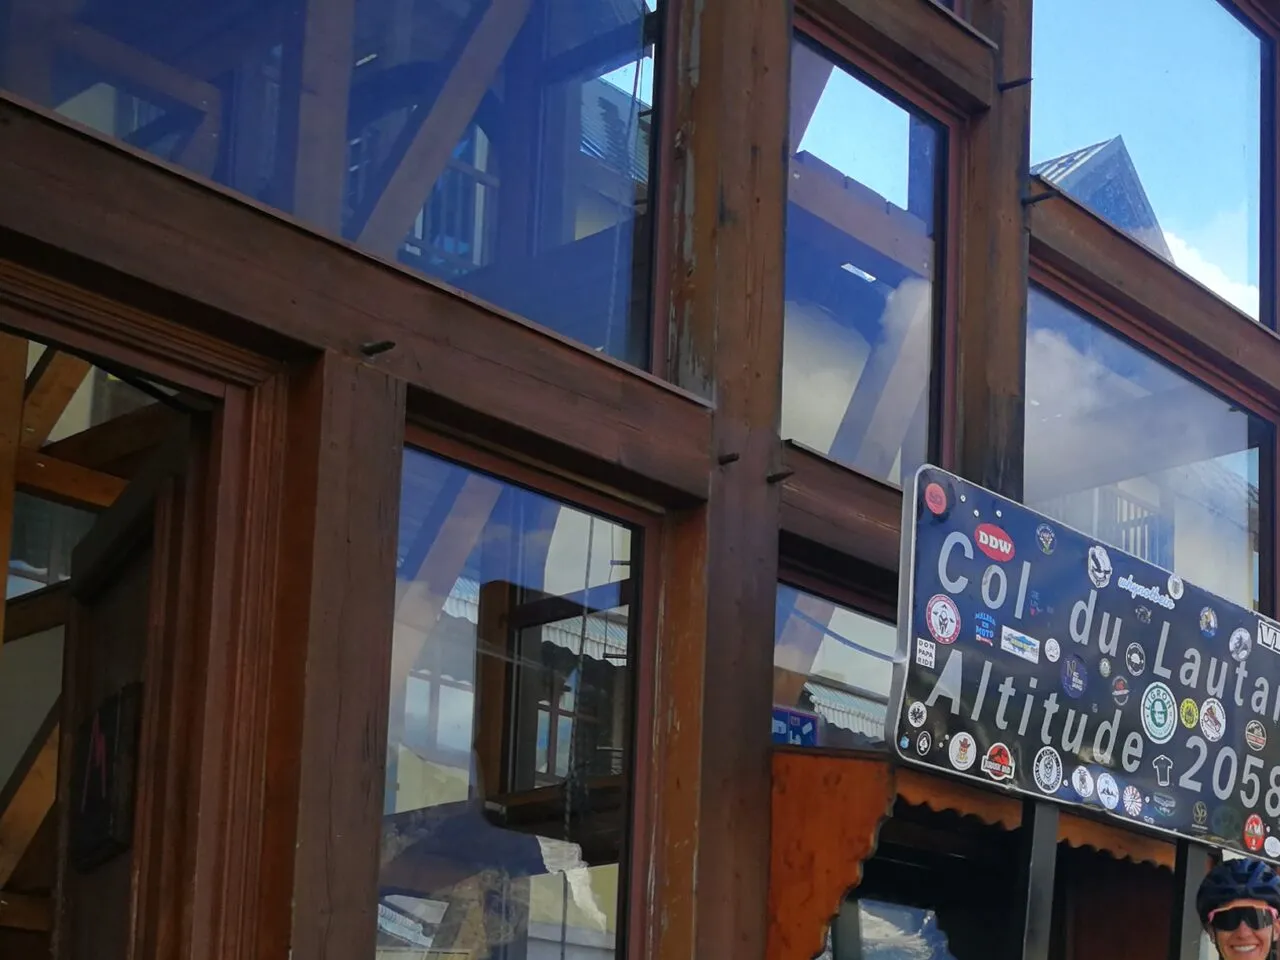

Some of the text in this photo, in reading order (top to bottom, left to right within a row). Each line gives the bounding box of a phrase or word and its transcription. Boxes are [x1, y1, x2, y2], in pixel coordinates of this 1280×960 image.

[979, 530, 1012, 555] DDW
[938, 531, 1031, 620] Col
[1069, 589, 1122, 657] du
[918, 649, 933, 660] PAPA
[919, 640, 934, 650] DON
[925, 649, 1143, 773] Altitude
